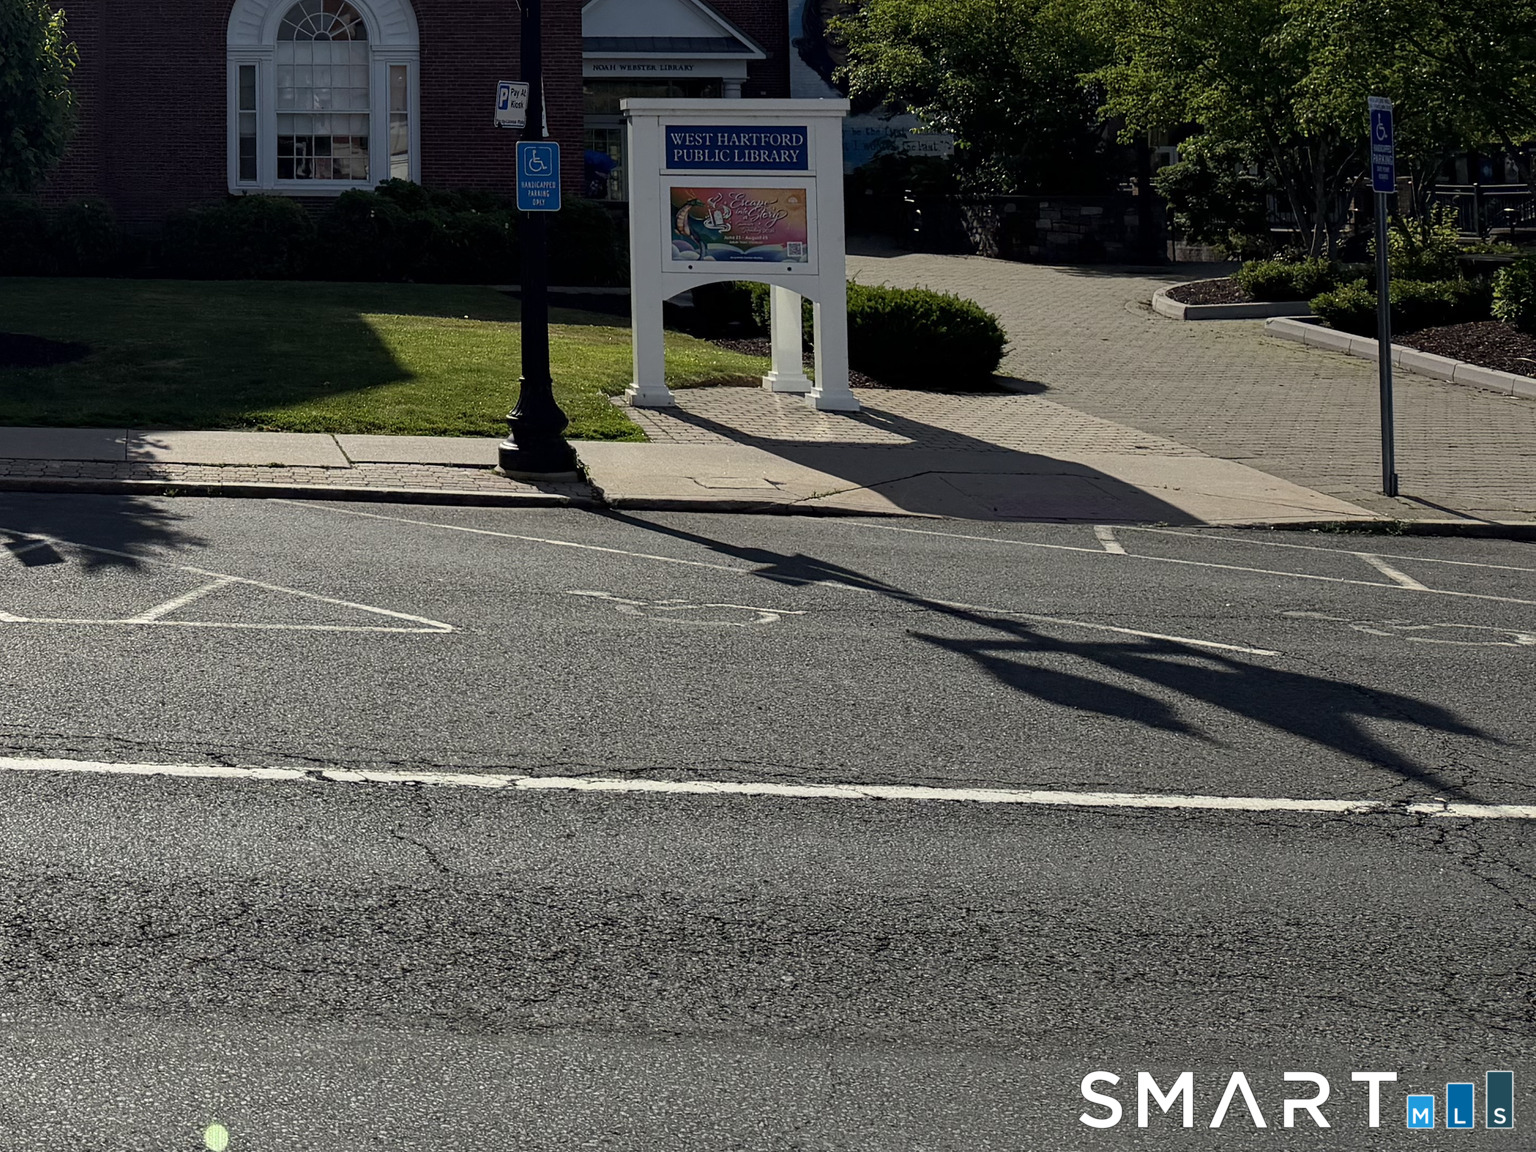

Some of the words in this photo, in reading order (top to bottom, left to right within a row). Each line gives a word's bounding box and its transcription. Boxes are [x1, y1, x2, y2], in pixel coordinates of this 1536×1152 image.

[499, 87, 508, 108] P
[511, 88, 519, 98] Pay
[511, 100, 524, 109] Kiosk
[670, 133, 713, 146] WEST
[717, 133, 803, 146] HARTFORD
[674, 149, 730, 162] PUBLIC
[734, 149, 799, 162] LIBRARY
[521, 181, 556, 189] HANDICAPPED
[528, 190, 550, 198] PARKING
[532, 198, 545, 206] ONLY
[748, 205, 788, 228] Story
